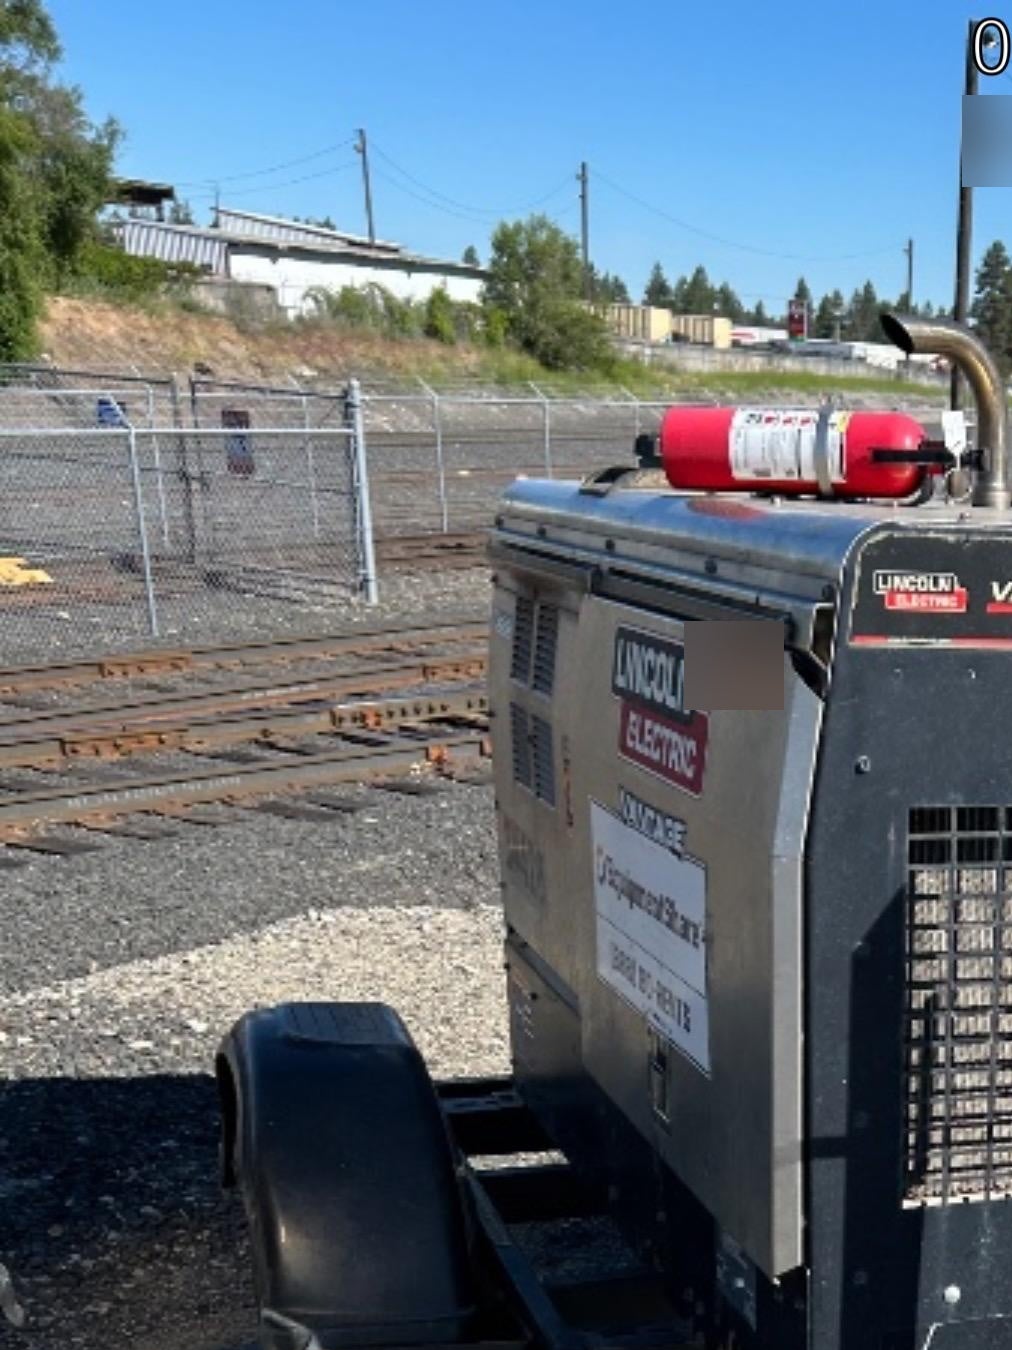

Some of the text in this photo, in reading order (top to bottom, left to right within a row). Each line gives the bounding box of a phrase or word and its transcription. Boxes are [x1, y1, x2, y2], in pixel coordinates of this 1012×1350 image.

[878, 575, 956, 592] LINCOLN
[895, 594, 958, 607] ELECTRIC
[626, 711, 696, 780] ELECTRIC
